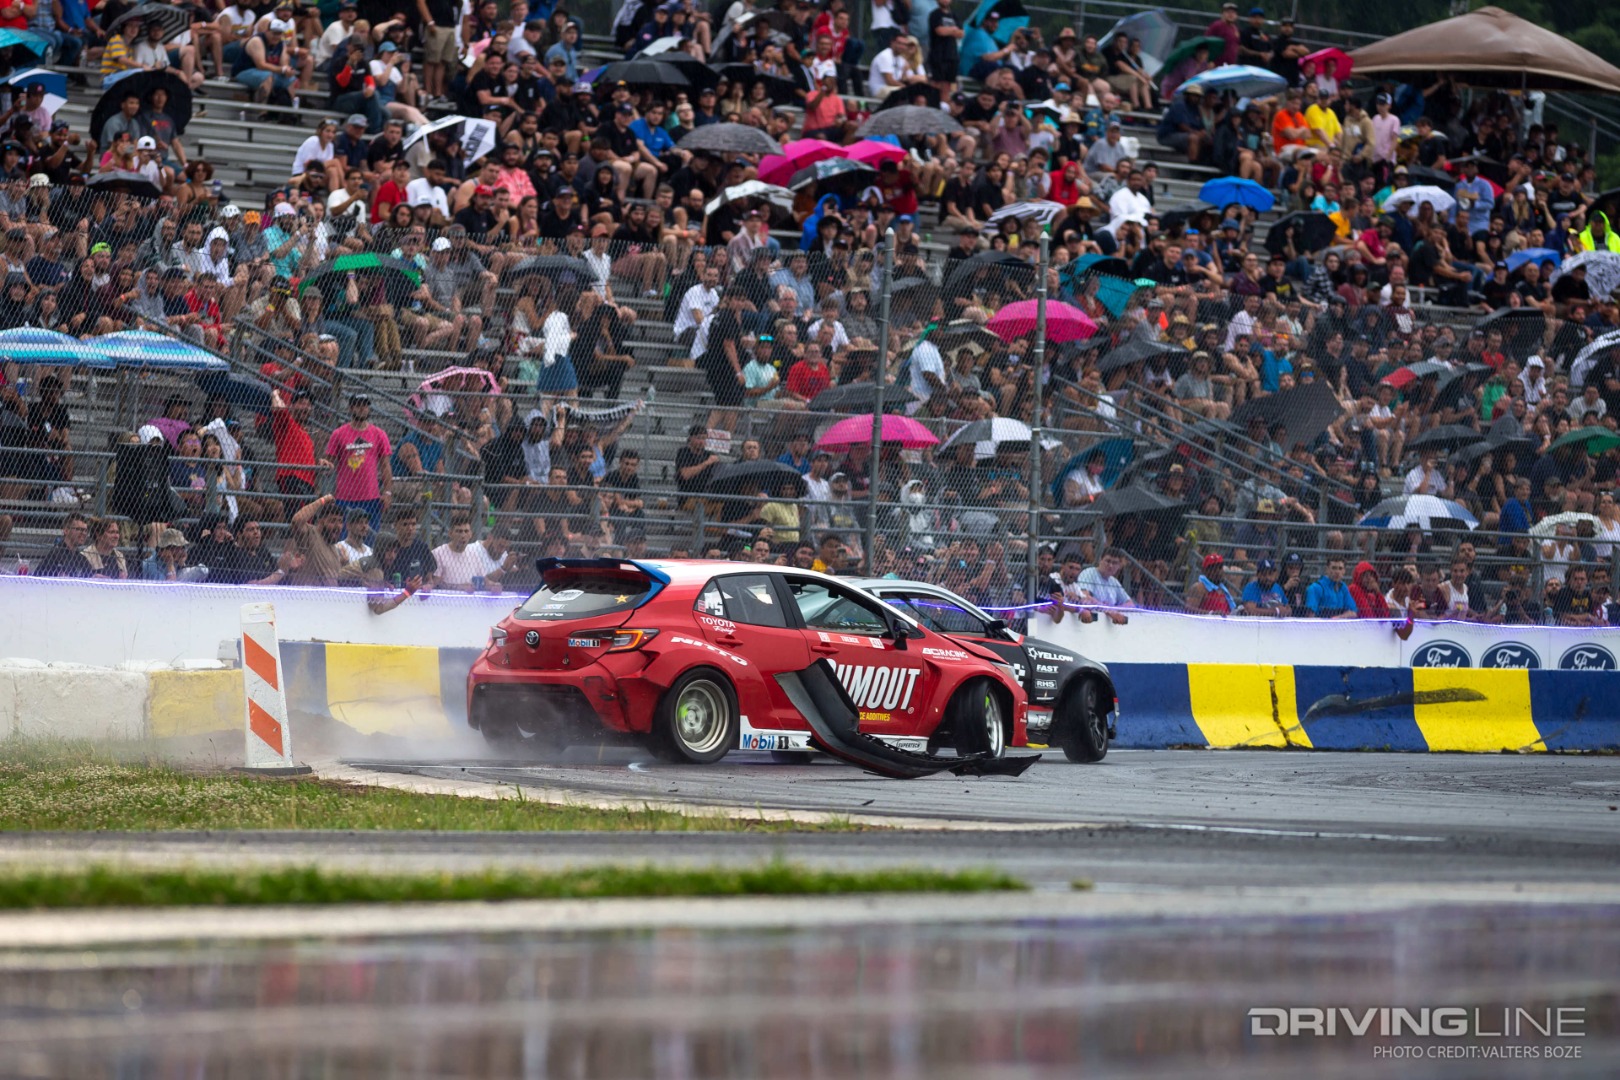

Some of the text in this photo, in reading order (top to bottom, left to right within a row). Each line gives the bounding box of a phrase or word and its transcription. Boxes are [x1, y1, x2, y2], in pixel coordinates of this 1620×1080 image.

[700, 616, 736, 628] TOYOTA
[568, 639, 591, 647] Mobil
[670, 637, 748, 666] NITTO
[1037, 651, 1074, 662] YELLOW
[1036, 664, 1059, 672] FAST
[1036, 680, 1055, 688] RHS
[866, 712, 891, 721] ADDITIVES
[742, 734, 775, 750] Mobil
